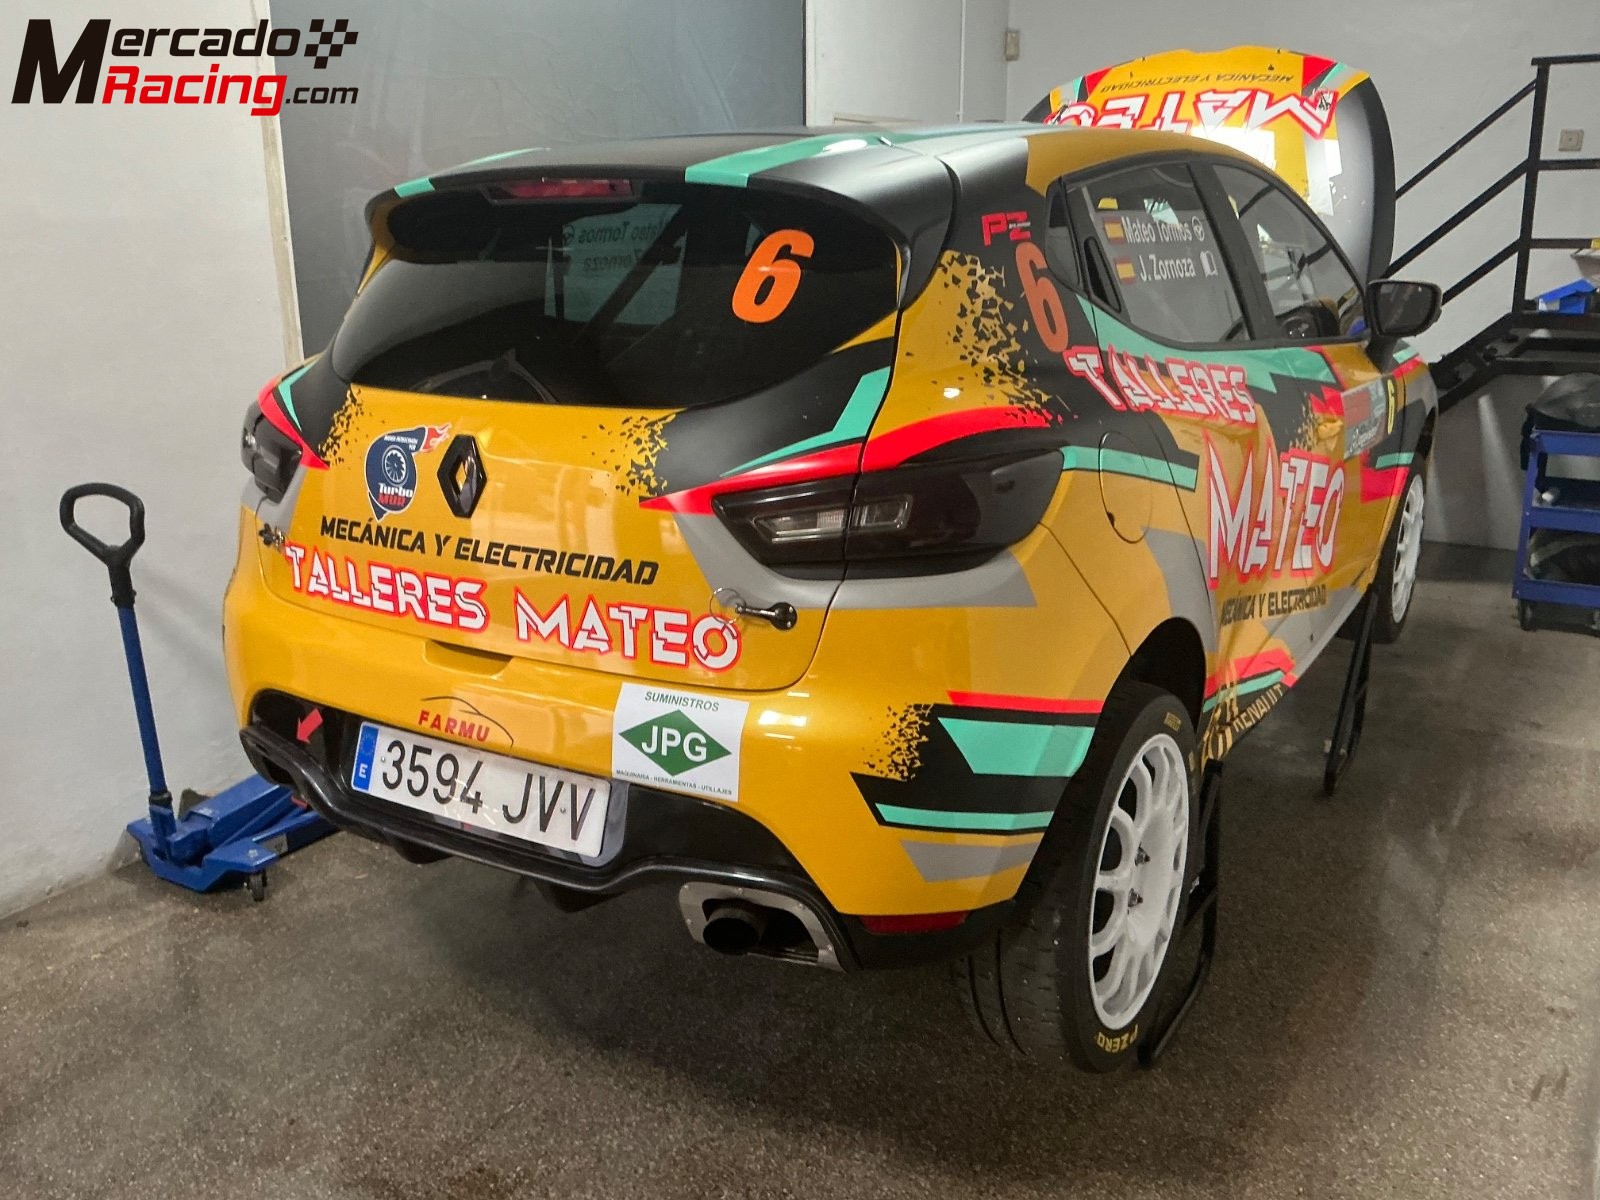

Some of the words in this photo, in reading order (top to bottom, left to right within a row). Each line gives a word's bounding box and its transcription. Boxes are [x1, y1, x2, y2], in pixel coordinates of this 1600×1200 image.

[1121, 216, 1156, 243] Mateo
[1157, 220, 1192, 242] Tormos
[732, 229, 815, 324] 6
[1139, 254, 1152, 282] J.
[1149, 253, 1197, 280] Zornoza
[1015, 242, 1069, 353] 6
[1063, 345, 1258, 426] TALLERES
[378, 482, 414, 498] Turbo
[1203, 430, 1345, 588] MATEO
[320, 515, 426, 554] MECÁNICA
[434, 533, 452, 557] Y
[454, 537, 659, 585] ELECTRICIDAD
[284, 540, 491, 634] TALLERES
[514, 586, 743, 672] MATEO
[1258, 593, 1268, 619] Y
[644, 691, 720, 712] SUMINISTROS
[418, 710, 490, 742] FARMU
[641, 725, 707, 762] JPG
[358, 763, 367, 779] E
[653, 776, 697, 790] HERRAMIENTAS
[382, 739, 484, 814] 3594
[502, 772, 596, 841] JVV
